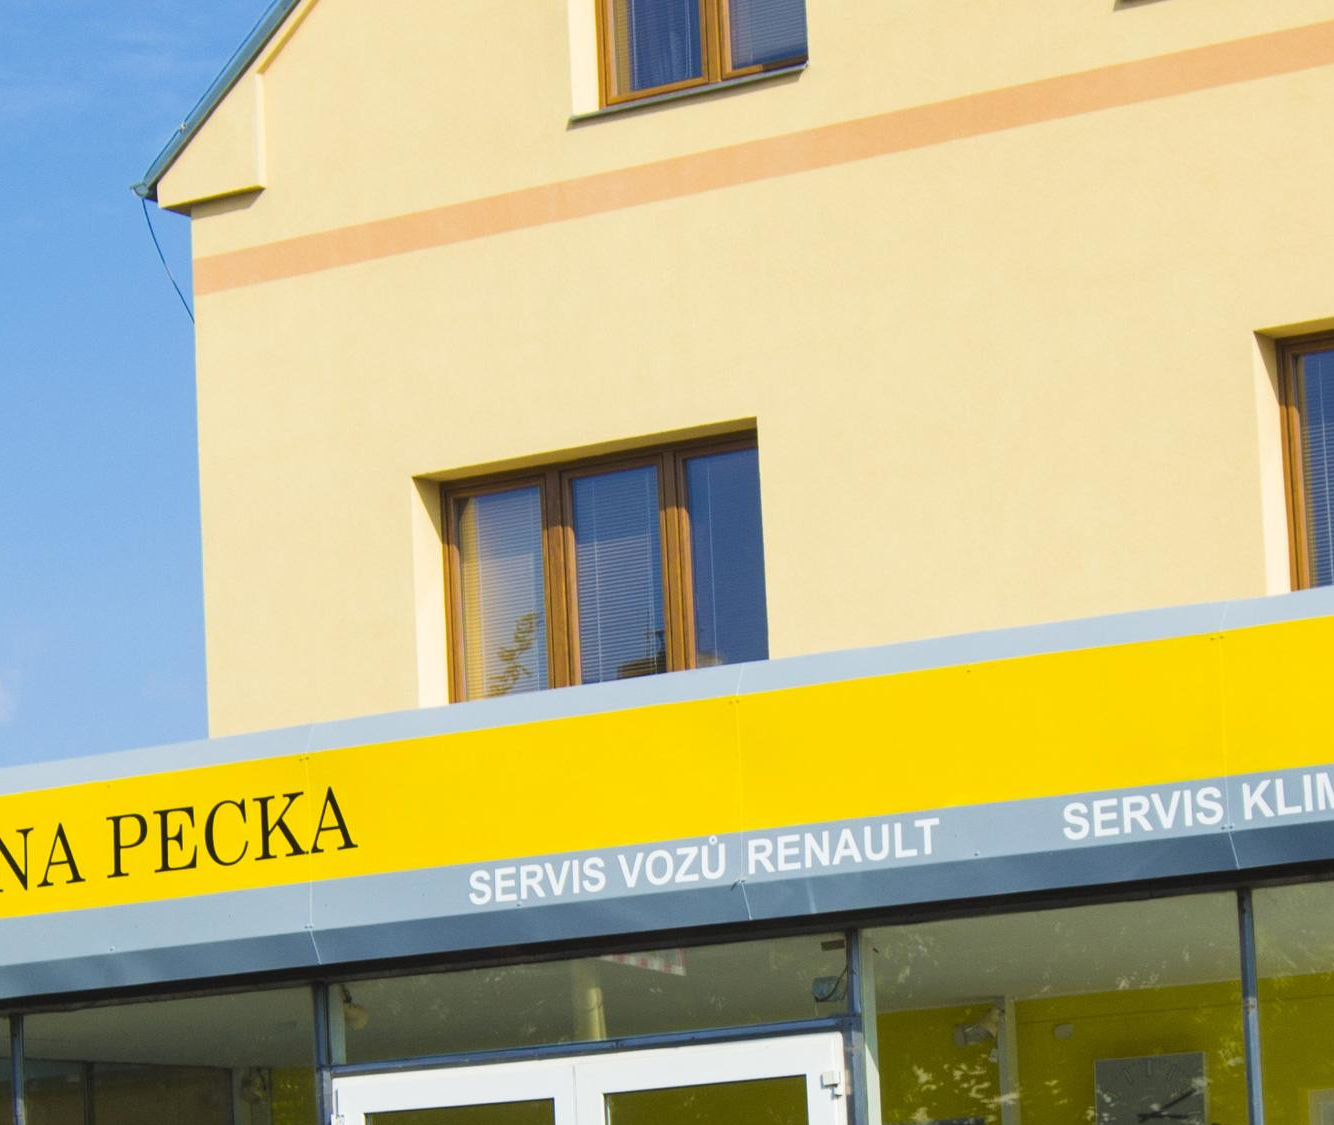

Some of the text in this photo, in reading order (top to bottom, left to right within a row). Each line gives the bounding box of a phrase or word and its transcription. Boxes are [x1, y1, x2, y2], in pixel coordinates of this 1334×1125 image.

[105, 785, 359, 879] PECKA
[1062, 785, 1223, 841] SERVIS
[468, 818, 940, 905] SERVIS VOZŮ RENAULT
